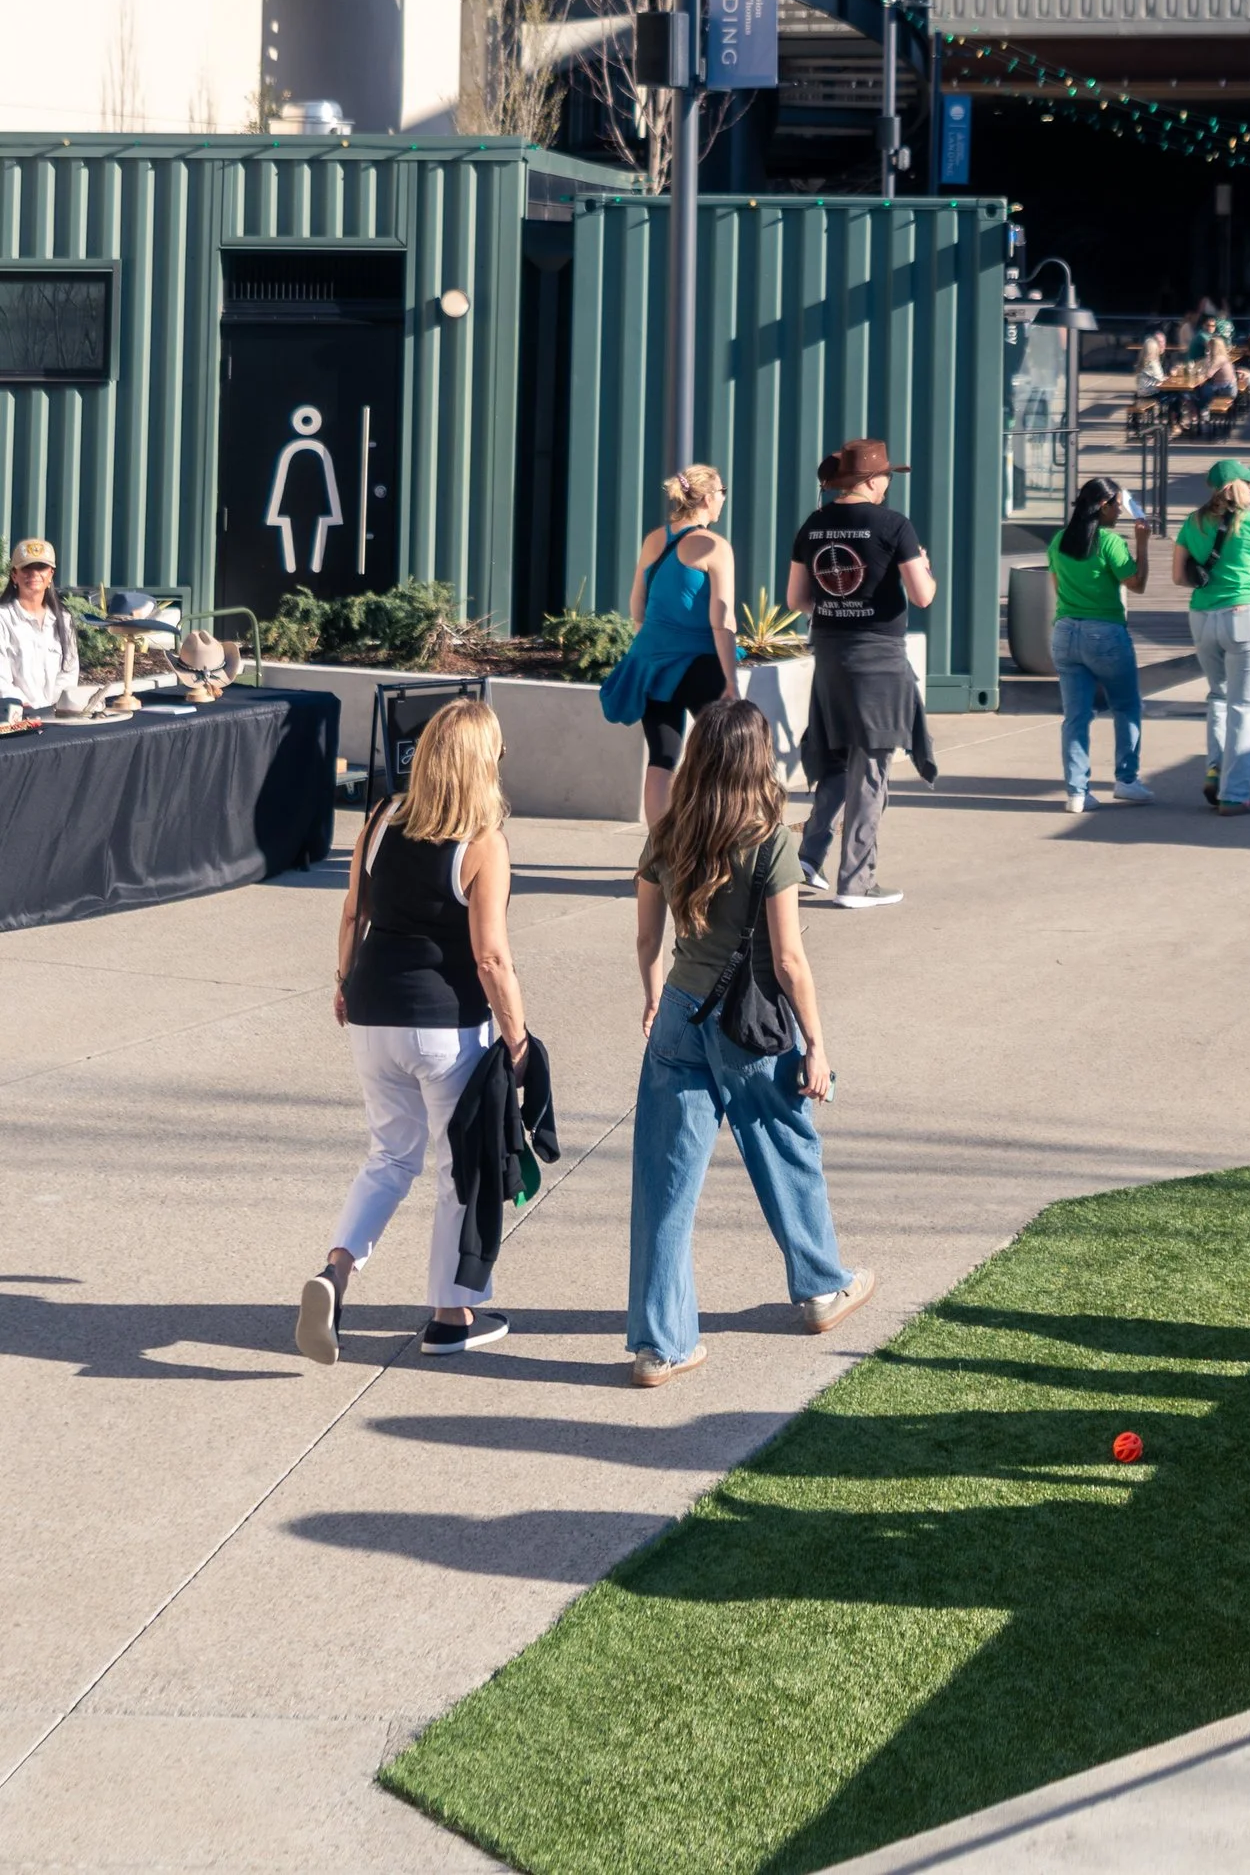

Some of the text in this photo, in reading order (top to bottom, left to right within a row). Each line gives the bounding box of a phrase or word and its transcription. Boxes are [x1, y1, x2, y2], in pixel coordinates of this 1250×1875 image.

[809, 530, 871, 540] THE HUNTERS
[822, 601, 864, 609] ARE NOW
[817, 607, 875, 618] THE HUNTED
